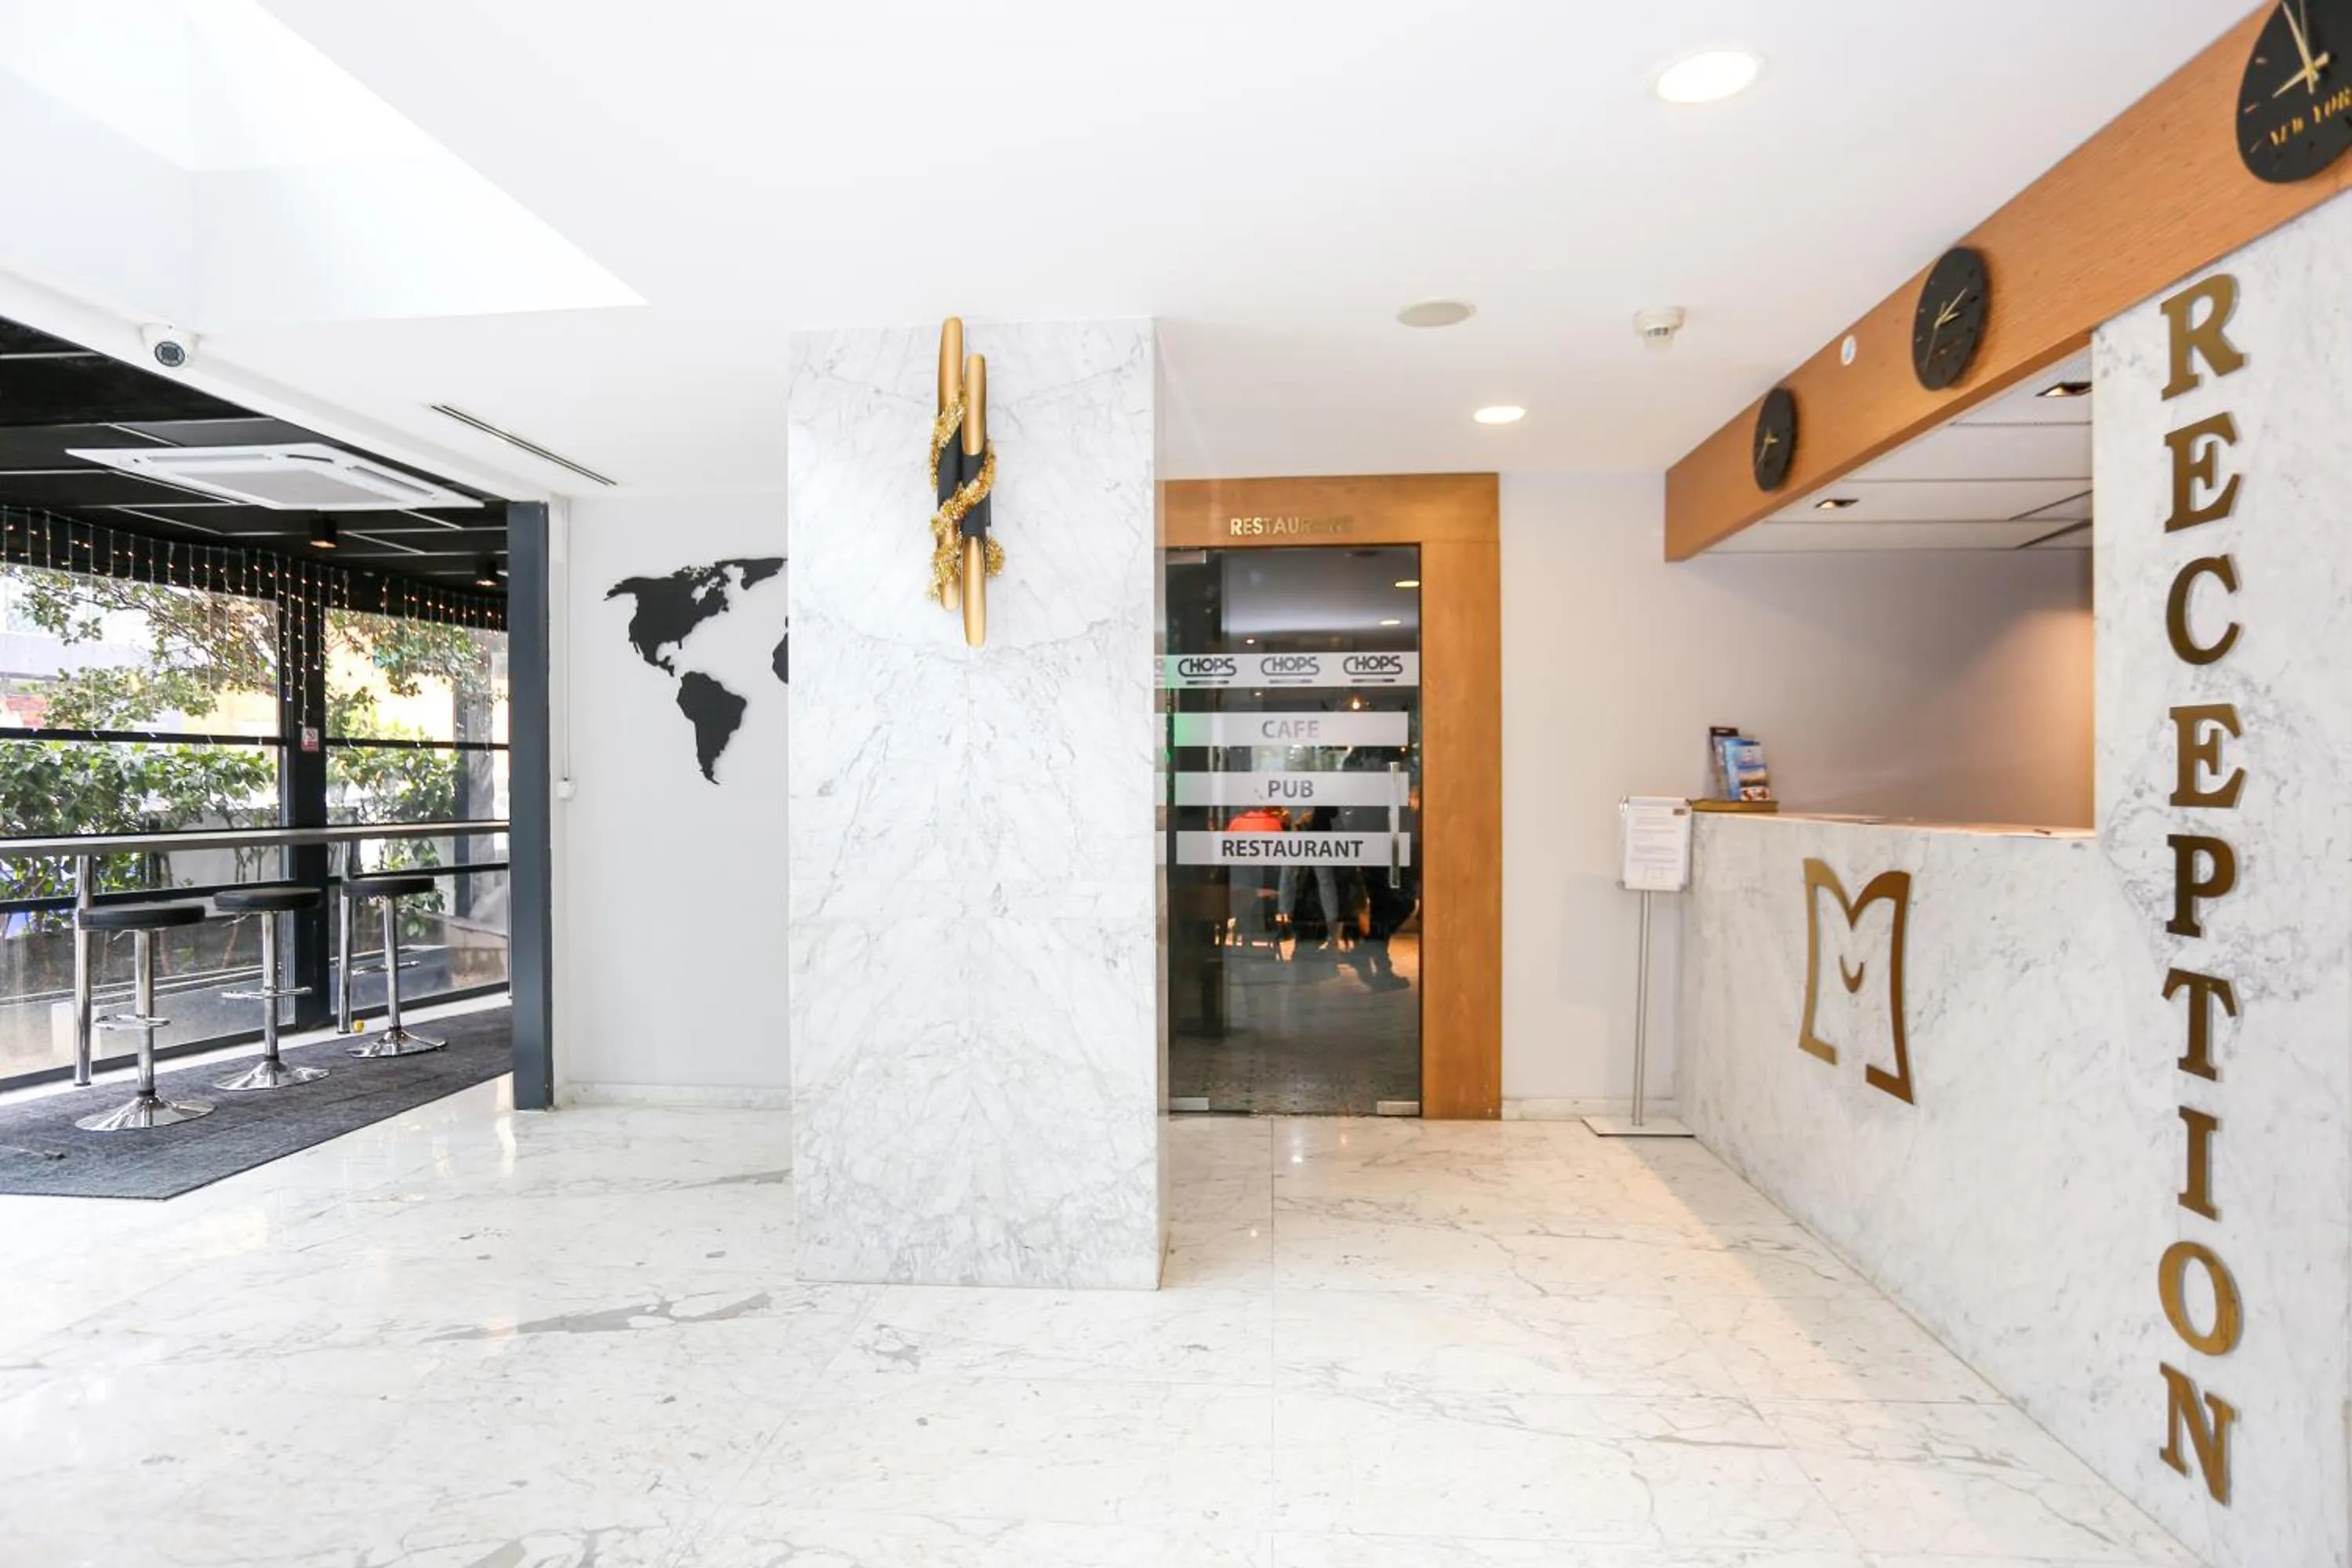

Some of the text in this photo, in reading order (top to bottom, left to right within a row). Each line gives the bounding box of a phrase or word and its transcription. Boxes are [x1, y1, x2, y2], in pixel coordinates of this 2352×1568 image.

[2270, 85, 2352, 147] NEW YOR
[1178, 657, 1237, 677] CHOPS
[1260, 656, 1320, 676] CHOPS
[1343, 655, 1403, 675] CHOPS
[1261, 720, 1320, 739] CAFE
[1268, 780, 1314, 798] PUB
[1221, 840, 1363, 858] RESTAURANT
[2158, 273, 2248, 1506] RECEPTION
